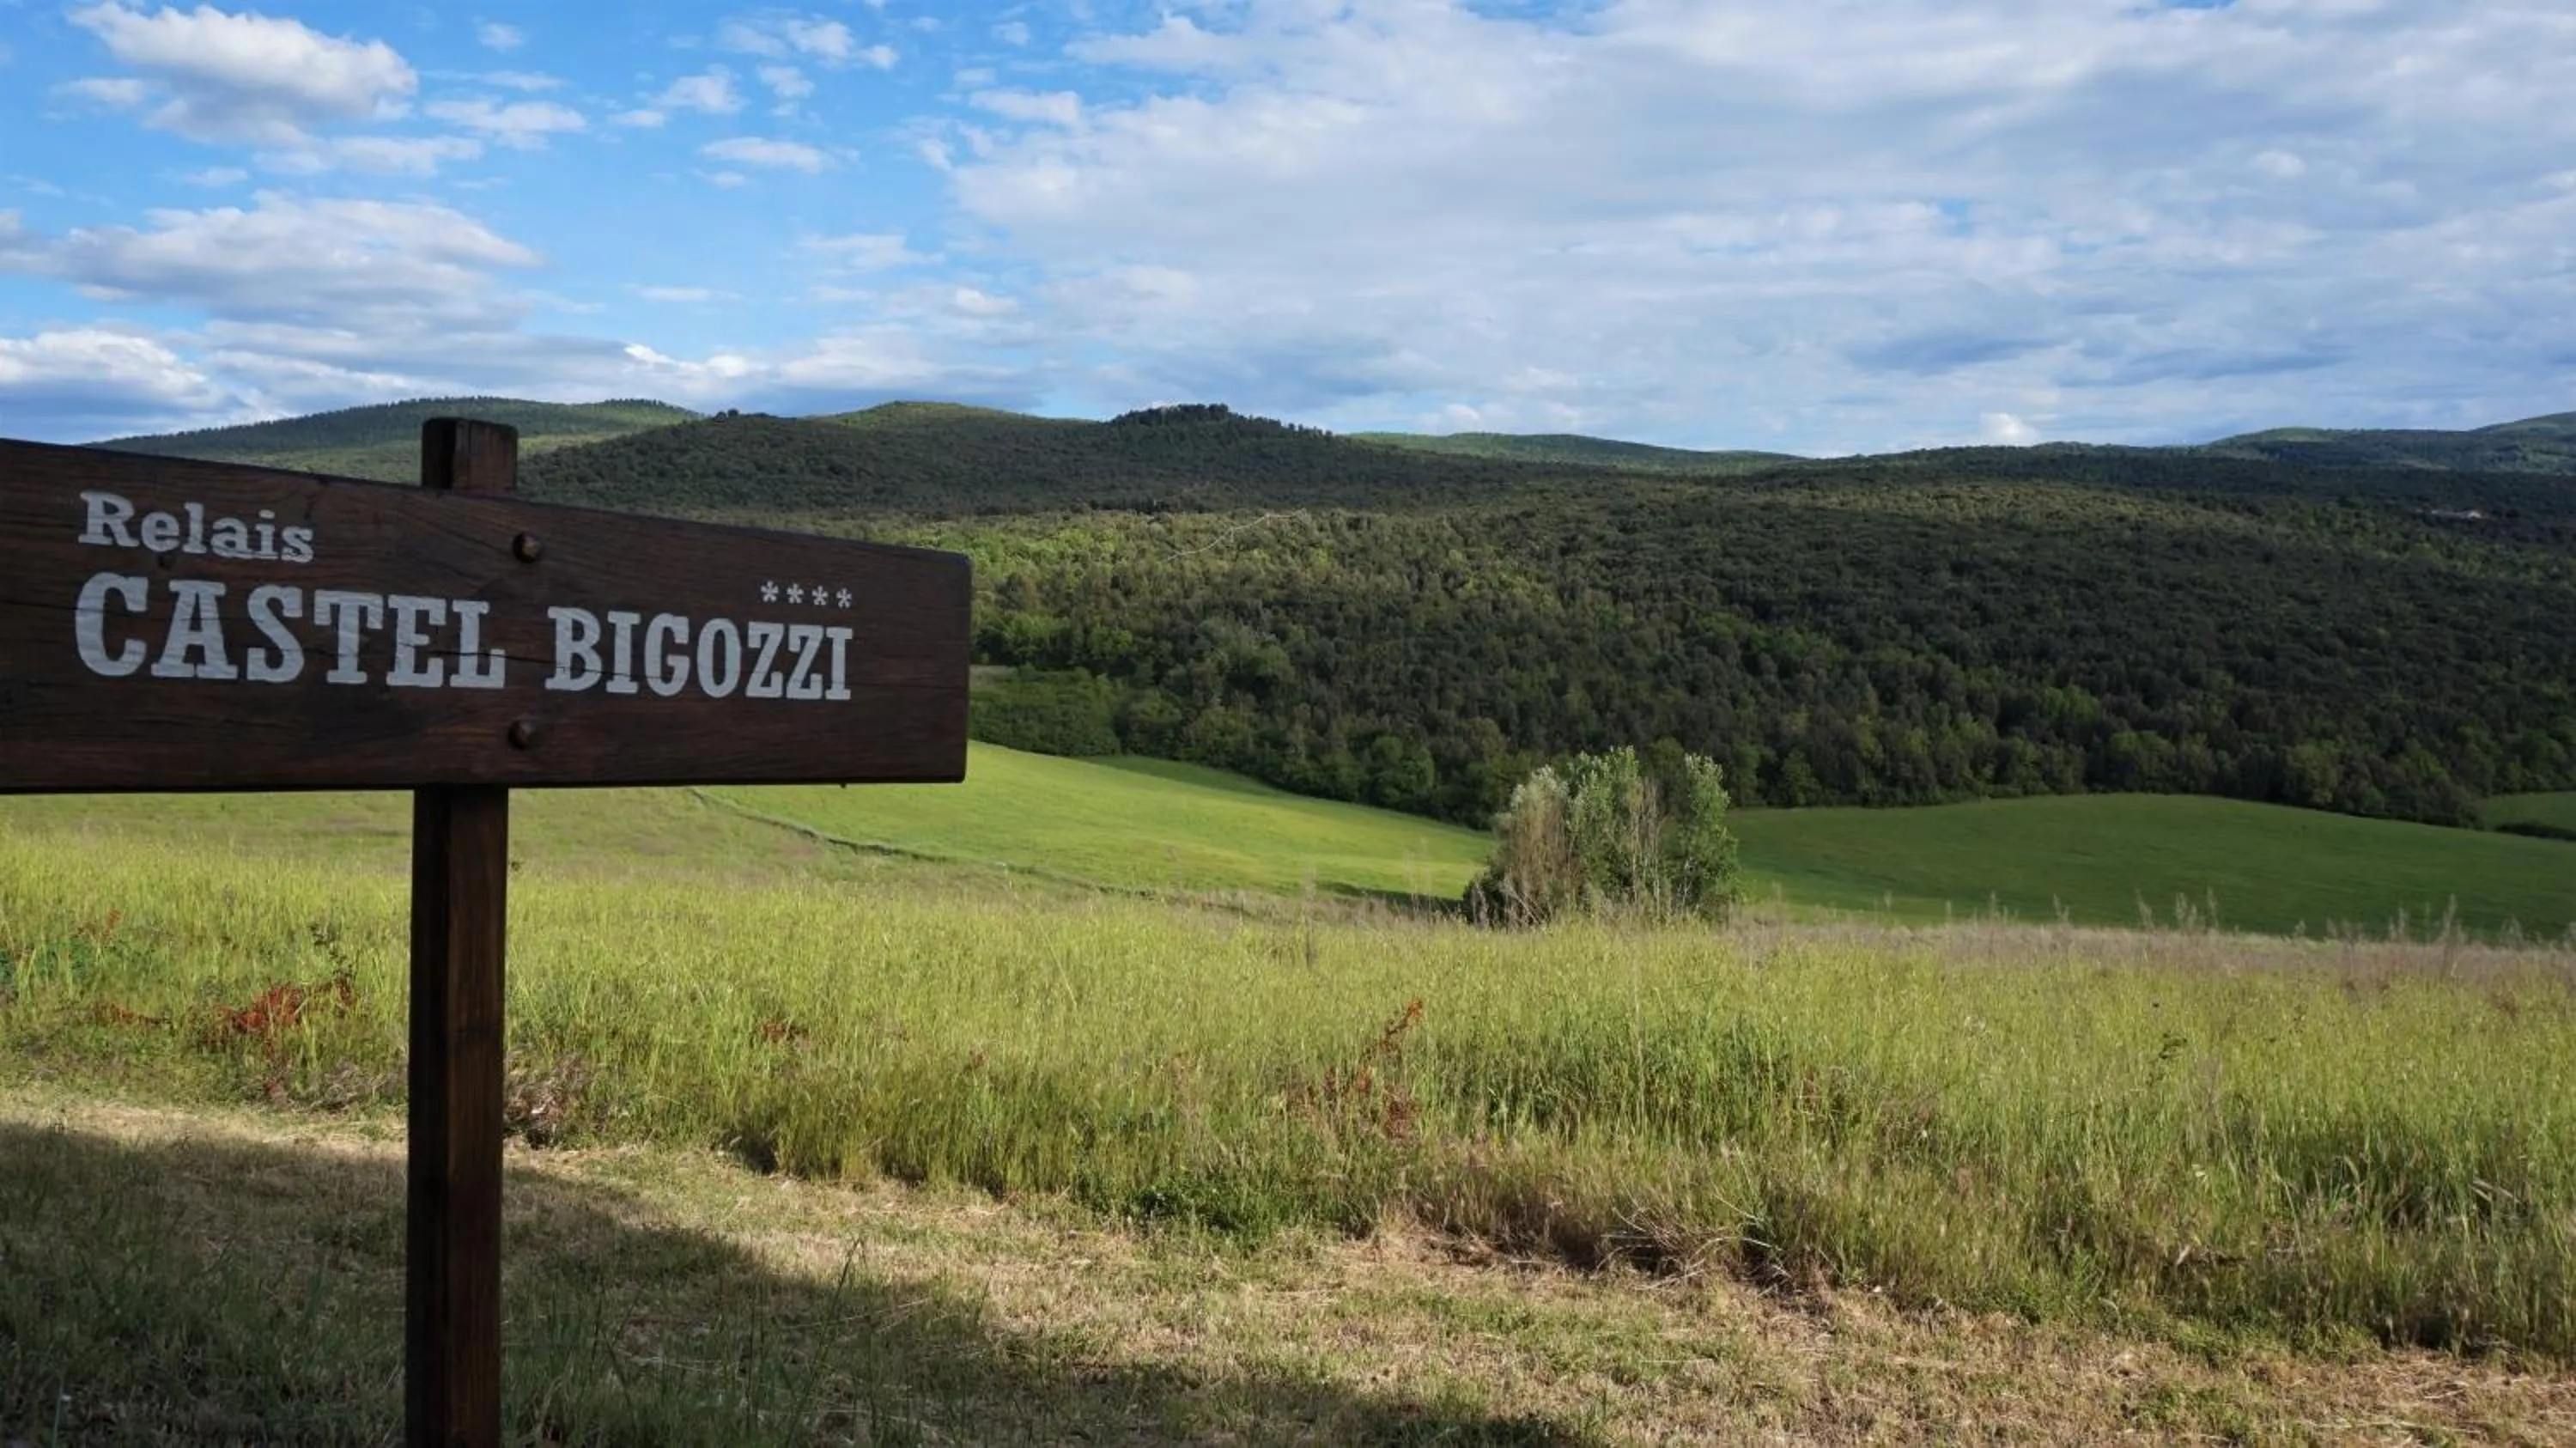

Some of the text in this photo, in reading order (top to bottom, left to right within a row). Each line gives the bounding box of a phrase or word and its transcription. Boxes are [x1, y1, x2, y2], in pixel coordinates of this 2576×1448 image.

[78, 490, 314, 563] Relais
[75, 572, 853, 701] CASTEL BIGOZZI
